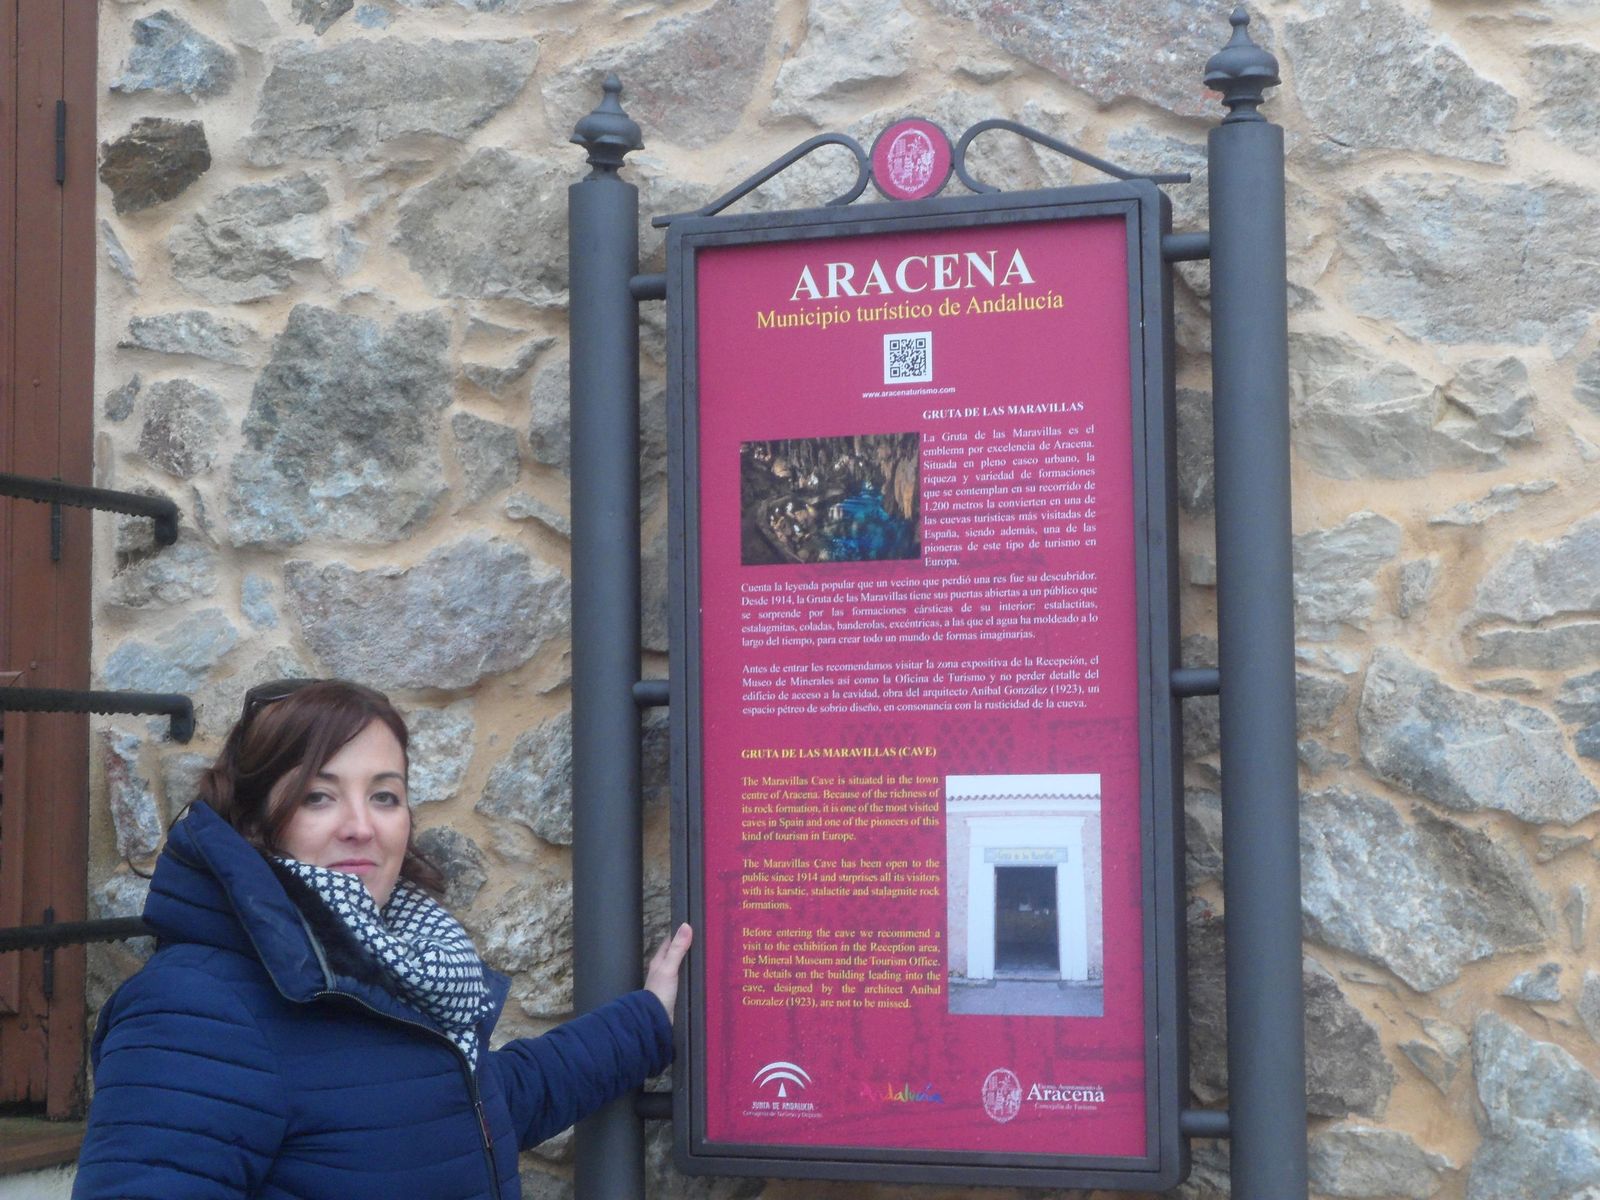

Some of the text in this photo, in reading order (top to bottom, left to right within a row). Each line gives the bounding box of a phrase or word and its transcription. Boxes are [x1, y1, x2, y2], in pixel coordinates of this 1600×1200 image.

[789, 248, 1036, 302] ARACENA
[756, 290, 1064, 330] Municipio turístico de Andalucía
[861, 386, 956, 399] www.aracenaturismo.com
[922, 402, 1083, 419] GRUTA DE LAS MARAVILLAS
[923, 432, 935, 442] La
[941, 431, 967, 441] Gruta
[974, 430, 985, 439] de
[992, 429, 1005, 438] las
[1012, 426, 1061, 437] Maravillas
[1085, 425, 1094, 434] el
[922, 445, 964, 456] emblema
[968, 446, 983, 456] por
[986, 442, 1035, 453] excelencia
[1038, 441, 1050, 450] de
[923, 459, 956, 470] Situada
[980, 457, 1006, 469] pleno
[1086, 453, 1094, 462] la
[923, 466, 1095, 485] riqueza y variedad de formaciones
[924, 515, 936, 524] las
[939, 516, 971, 524] cuevas
[1018, 511, 1037, 521] más
[1041, 510, 1081, 520] visitadas
[1084, 509, 1096, 518] de
[965, 527, 994, 537] siendo
[1065, 524, 1077, 533] de
[1083, 523, 1096, 532] las
[924, 542, 962, 554] pioneras
[967, 541, 978, 550] de
[982, 540, 1001, 550] este
[1005, 540, 1024, 551] tipo
[1028, 539, 1040, 548] de
[1044, 538, 1080, 548] turismo
[740, 582, 771, 592] Cuenta
[774, 582, 782, 591] la
[785, 581, 818, 593] leyenda
[821, 580, 854, 592] popular
[857, 581, 873, 591] que
[890, 577, 920, 587] vecino
[922, 579, 939, 588] que
[1009, 574, 1024, 584] fue
[758, 608, 801, 620] sorprende
[808, 610, 823, 619] por
[831, 607, 843, 616] las
[852, 605, 906, 616] formaciones
[960, 603, 972, 612] de
[742, 664, 767, 673] Antes
[769, 663, 780, 672] de
[782, 663, 808, 672] entrar
[811, 662, 823, 671] les
[825, 661, 892, 671] recomendamos
[895, 660, 923, 669] visitar
[925, 660, 934, 669] la
[936, 661, 958, 669] zona
[960, 658, 1007, 670] expositiva
[1010, 658, 1021, 667] de
[1024, 657, 1032, 667] la
[1089, 656, 1098, 665] el
[741, 748, 936, 759] GRUTA DE LAS MARAVILLAS (CAVE)
[741, 775, 938, 786] The Maravillas Cave is situated in the town
[741, 831, 761, 840] kind
[763, 831, 773, 840] of
[775, 831, 808, 840] tourism
[811, 831, 819, 840] in
[742, 886, 761, 895] with
[764, 886, 774, 895] its
[811, 886, 850, 895] stalactite
[852, 886, 869, 895] and
[871, 886, 917, 897] stalagmite
[919, 886, 939, 895] rock
[742, 927, 772, 936] Before
[776, 928, 812, 939] entering
[816, 928, 830, 937] the
[877, 929, 930, 938] recommend
[742, 942, 760, 951] visit
[764, 942, 773, 951] to
[776, 942, 789, 951] the
[793, 942, 837, 951] exhibition
[840, 942, 849, 951] in
[852, 943, 866, 952] the
[870, 943, 915, 954] Reception
[742, 955, 756, 964] the
[758, 955, 792, 965] Mineral
[795, 956, 833, 965] Museum
[835, 956, 851, 965] and
[853, 956, 867, 965] the
[871, 957, 906, 966] Tourism
[773, 983, 812, 995] designed
[821, 984, 832, 995] by
[841, 984, 855, 993] the
[864, 984, 902, 994] architect
[1027, 1083, 1105, 1102] Aracena
